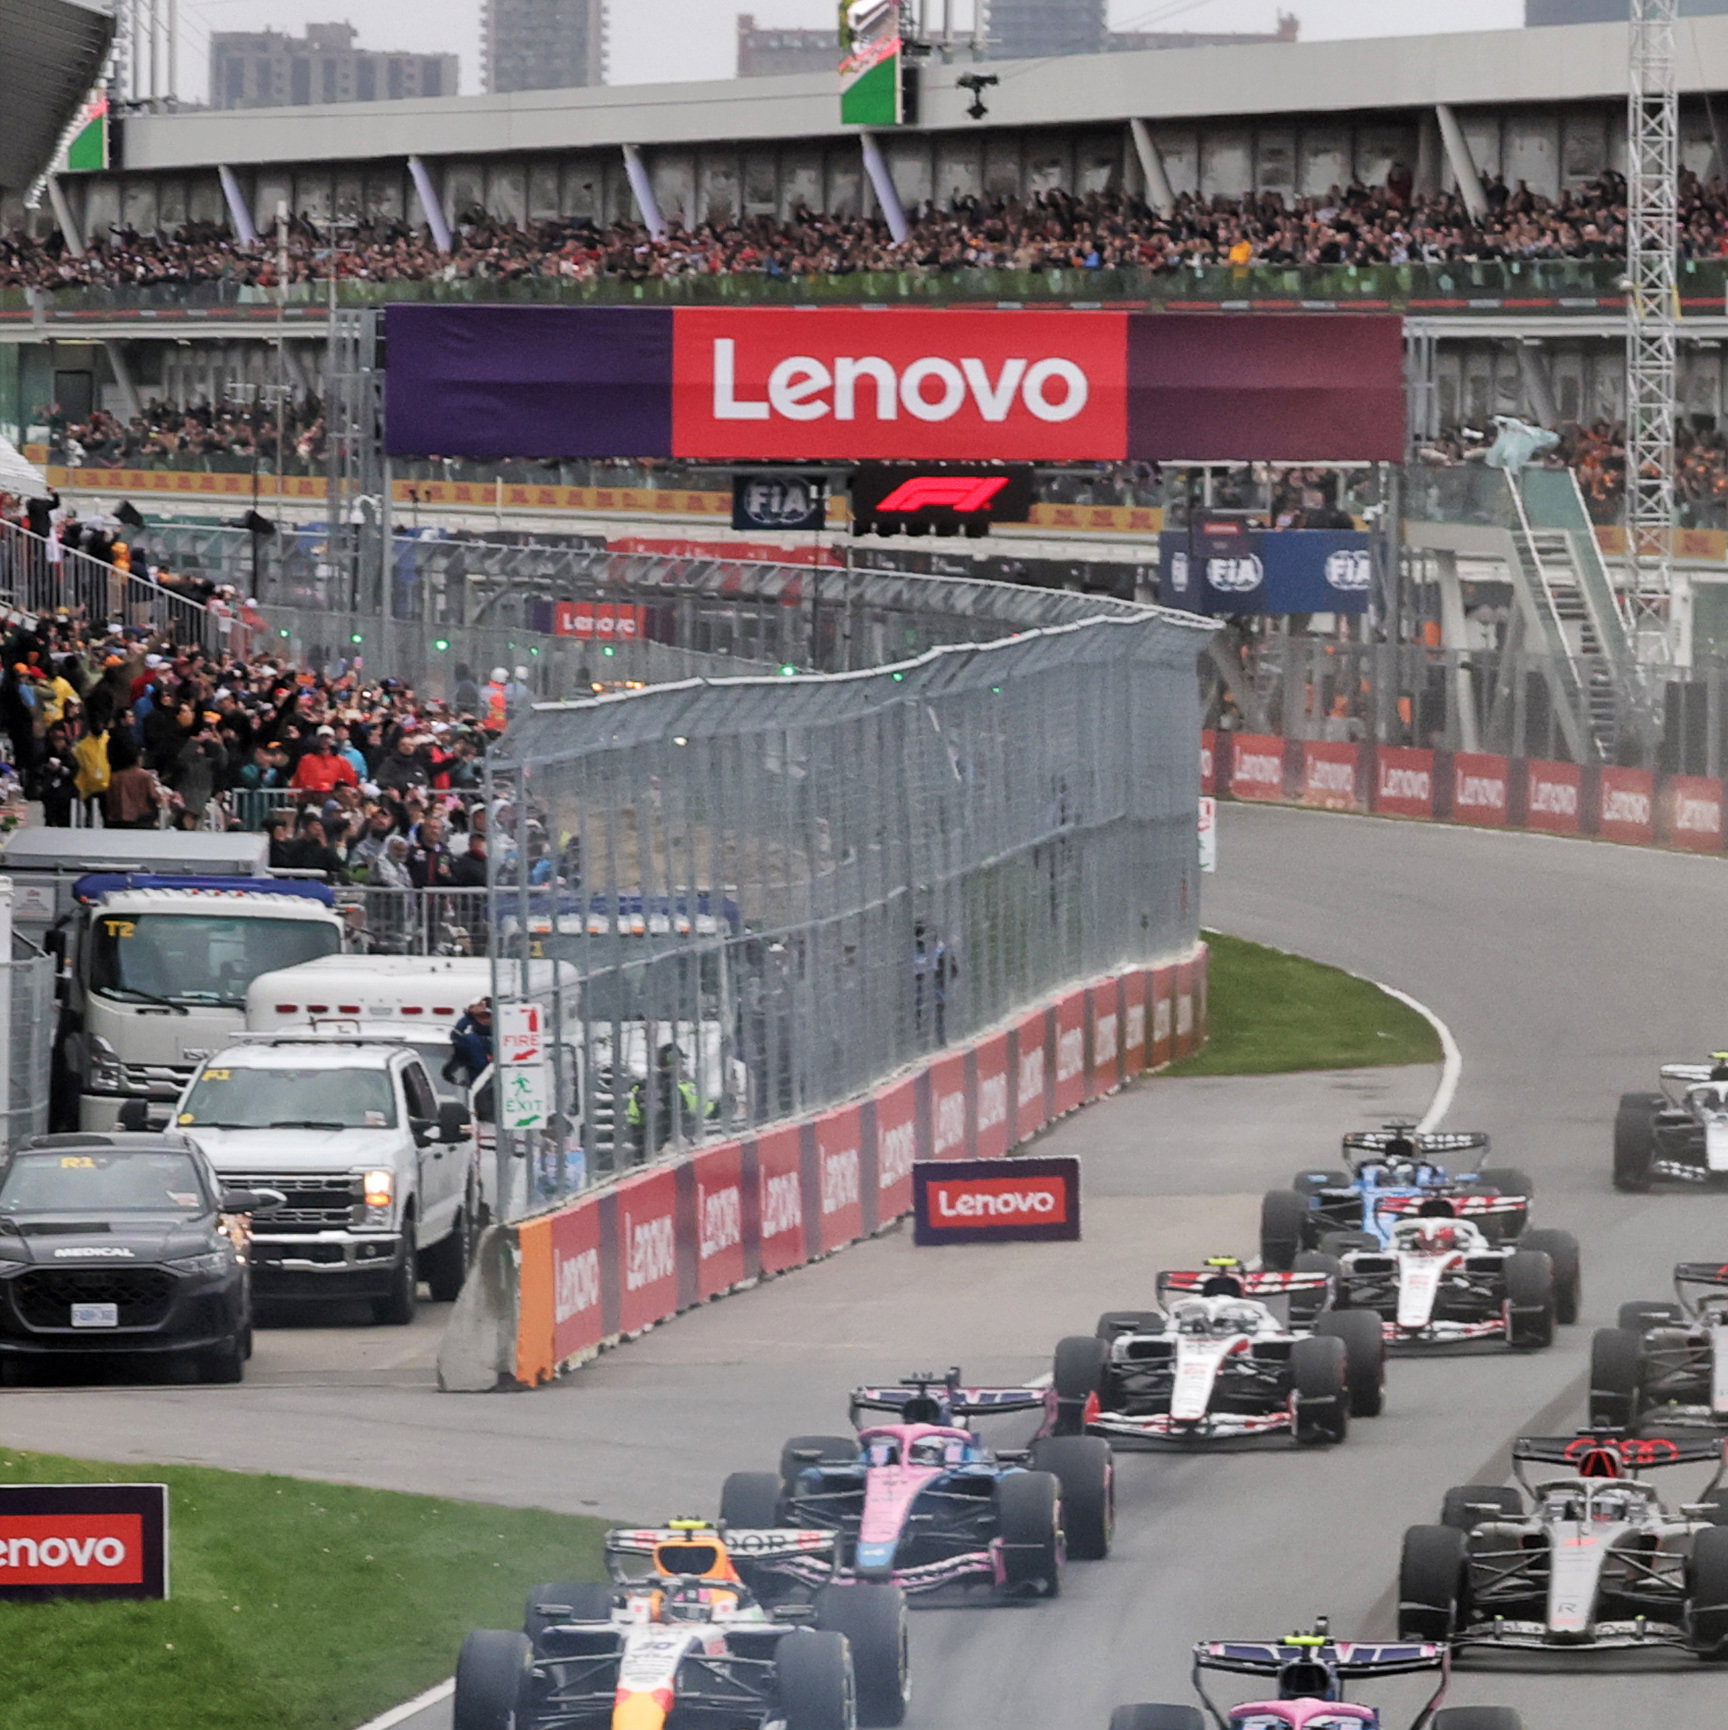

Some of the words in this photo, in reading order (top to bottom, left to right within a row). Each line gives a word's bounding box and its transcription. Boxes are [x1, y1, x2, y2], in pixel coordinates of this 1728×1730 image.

[713, 337, 1089, 422] Lenovo
[1210, 557, 1256, 582] FIA
[1234, 744, 1281, 784] Lenovo
[1379, 760, 1430, 799] Lenovo
[1456, 769, 1505, 809] Lenovo
[1529, 776, 1578, 816] Lenovo
[1602, 781, 1650, 824] Lenovo
[1676, 789, 1720, 834] Lenovo
[104, 920, 137, 938] T2
[503, 1034, 540, 1047] FIRE
[505, 1099, 543, 1112] EXIT
[977, 1066, 1008, 1132] Lenovo
[932, 1089, 965, 1154] Lenovo
[879, 1121, 916, 1185] Lenovo
[819, 1144, 860, 1209] Lenovo
[698, 1183, 740, 1260] Lenovo
[760, 1164, 801, 1239] Lenovo
[938, 1188, 1055, 1216] Lenovo
[54, 1246, 136, 1258] MEDICAL
[625, 1210, 675, 1291] Lenovo
[554, 1247, 599, 1324] Lenovo
[0, 1537, 126, 1567] novo
